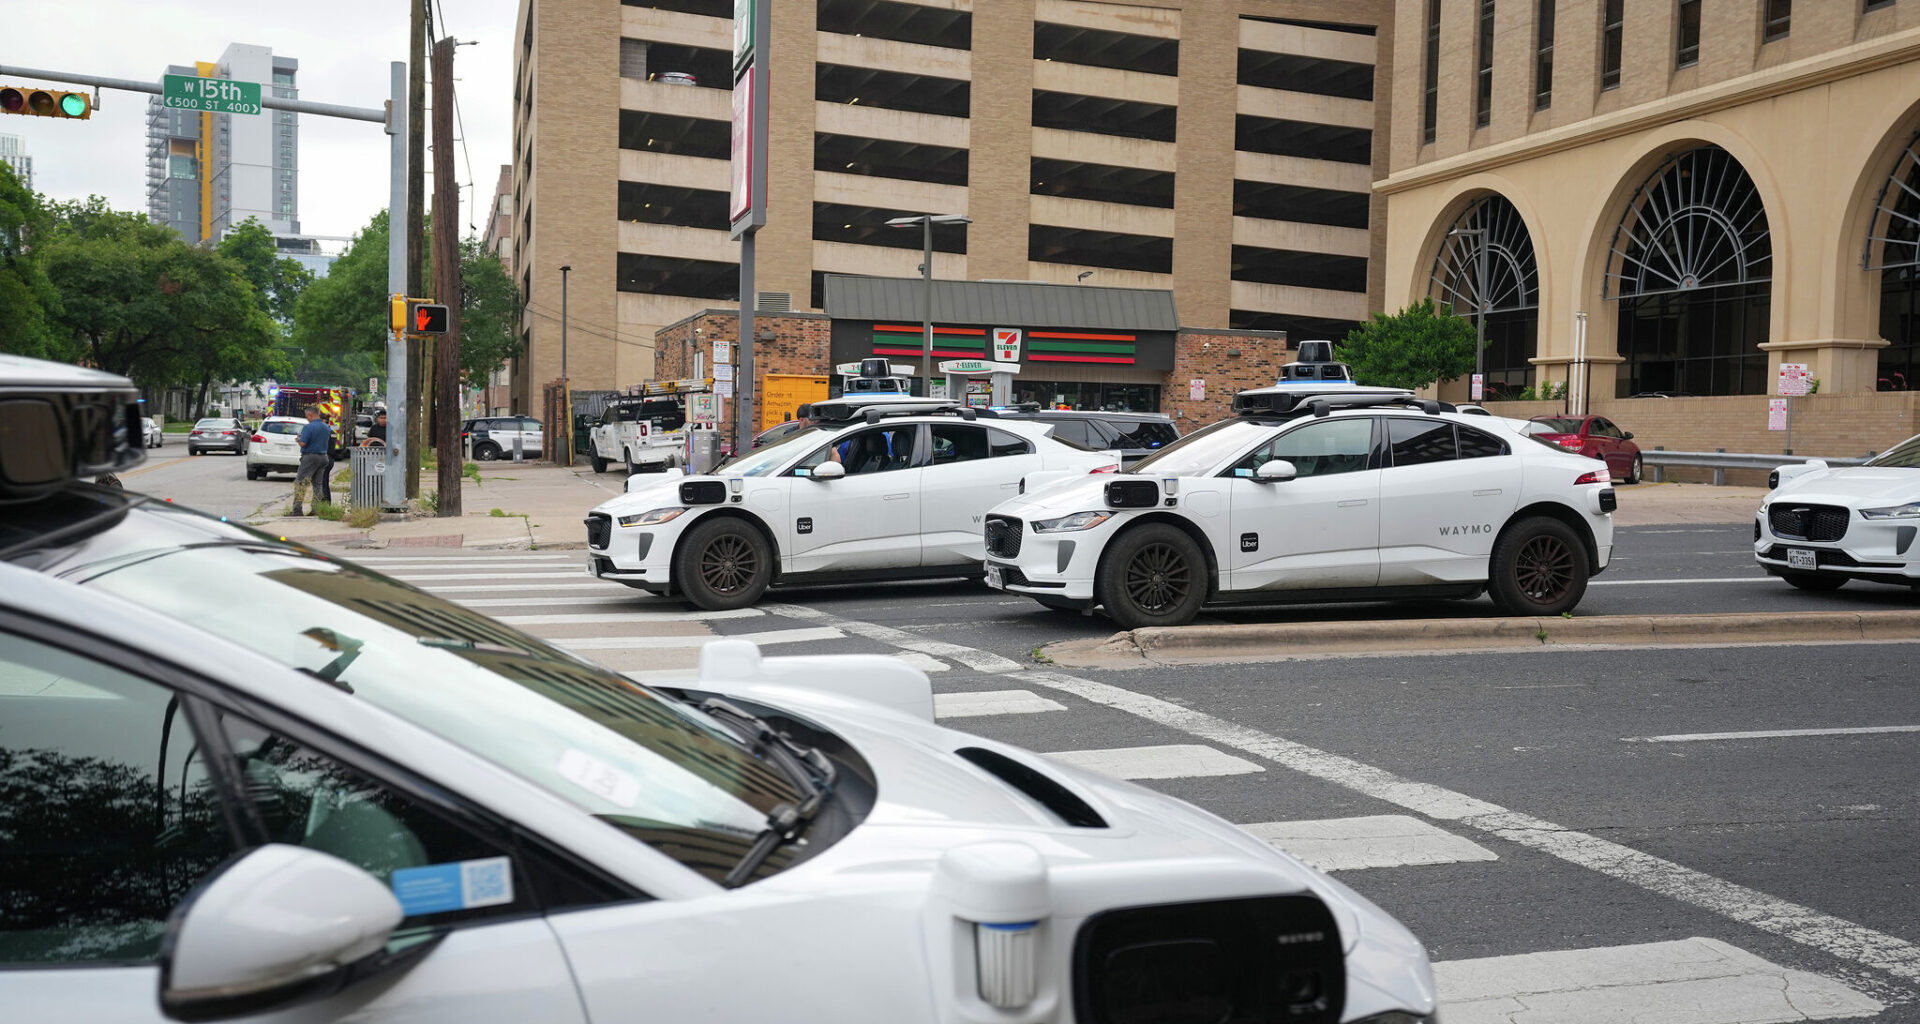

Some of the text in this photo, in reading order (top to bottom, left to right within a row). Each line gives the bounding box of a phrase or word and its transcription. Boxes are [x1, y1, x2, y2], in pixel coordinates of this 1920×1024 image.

[184, 79, 242, 101] W 15th
[175, 97, 250, 113] 500 ST 400
[1439, 524, 1492, 536] WAYMO
[1242, 540, 1258, 548] Uber
